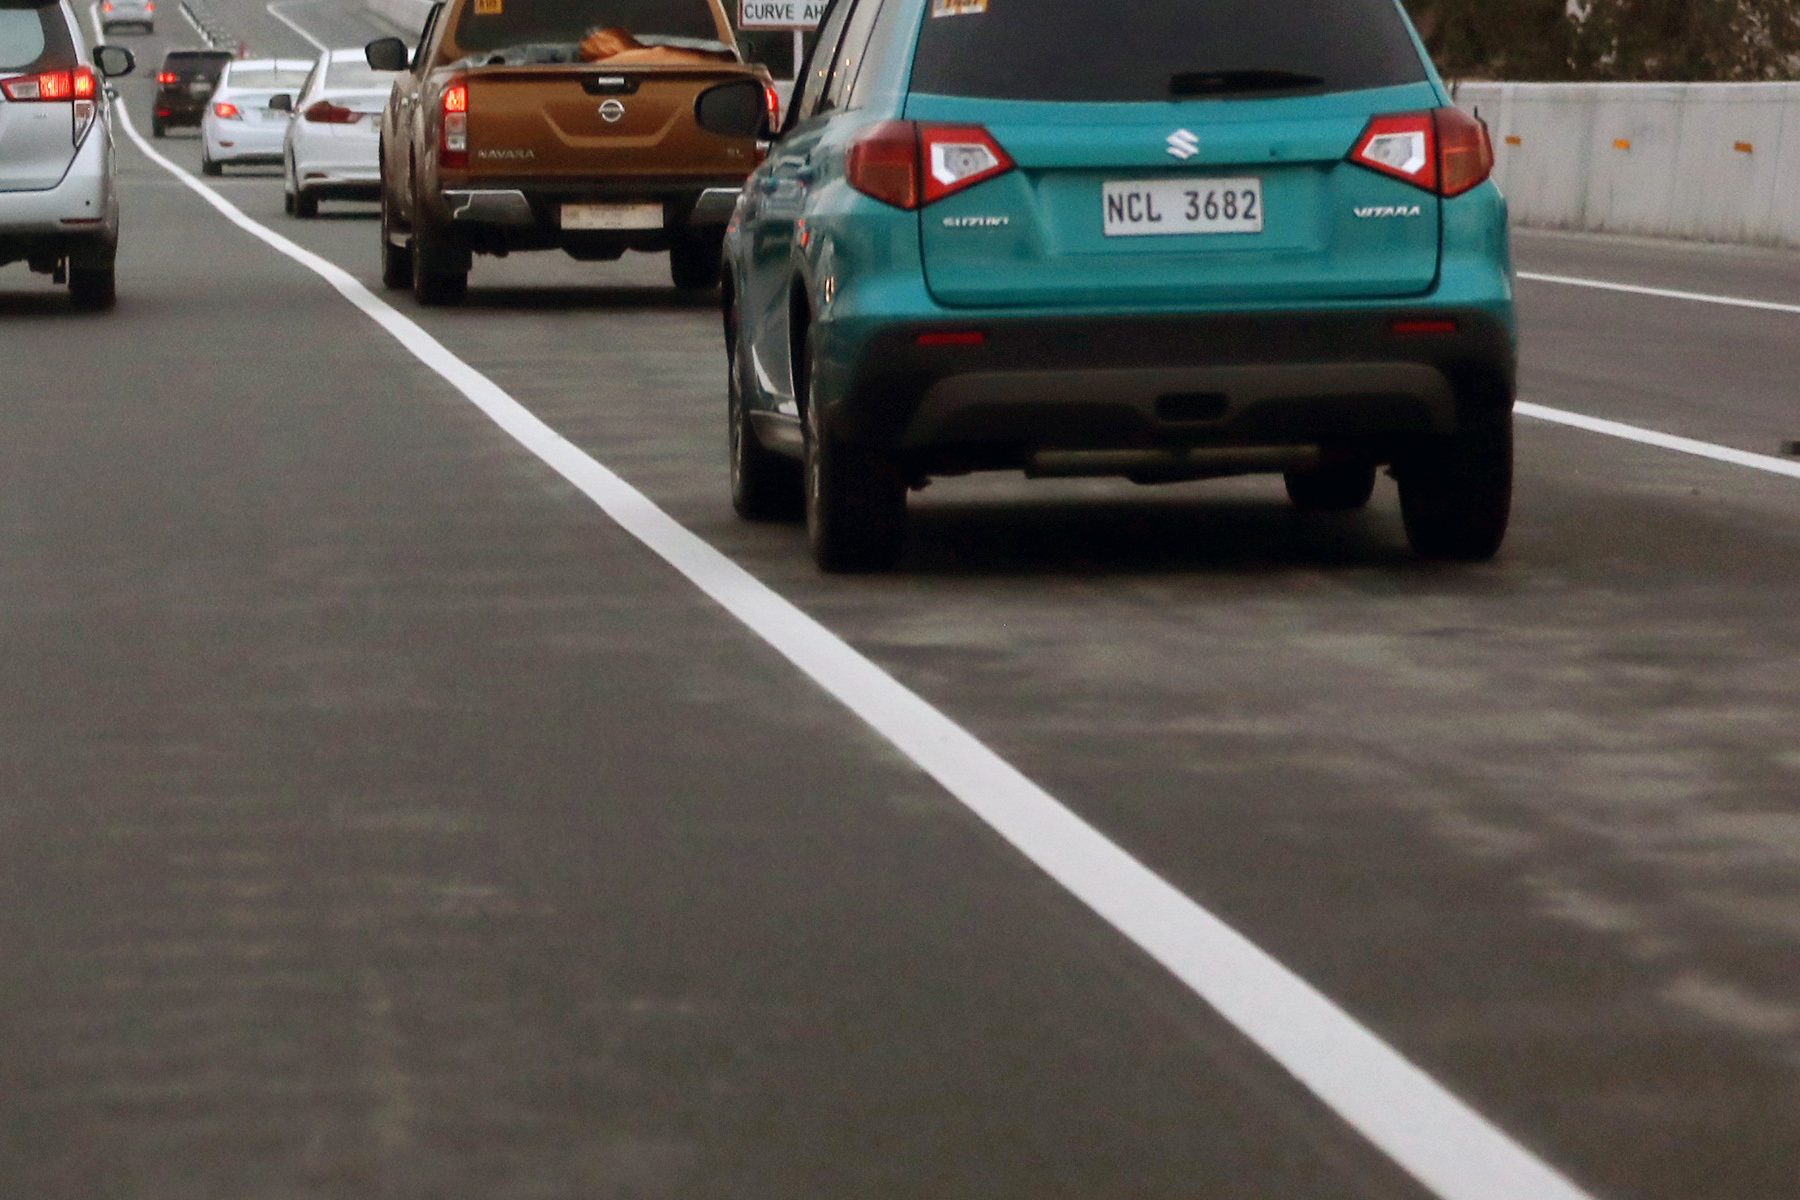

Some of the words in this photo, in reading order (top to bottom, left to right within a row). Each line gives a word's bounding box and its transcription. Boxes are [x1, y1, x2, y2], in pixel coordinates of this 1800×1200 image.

[744, 3, 795, 20] CURVE
[1107, 192, 1163, 224] NCL
[1183, 190, 1257, 221] 3682
